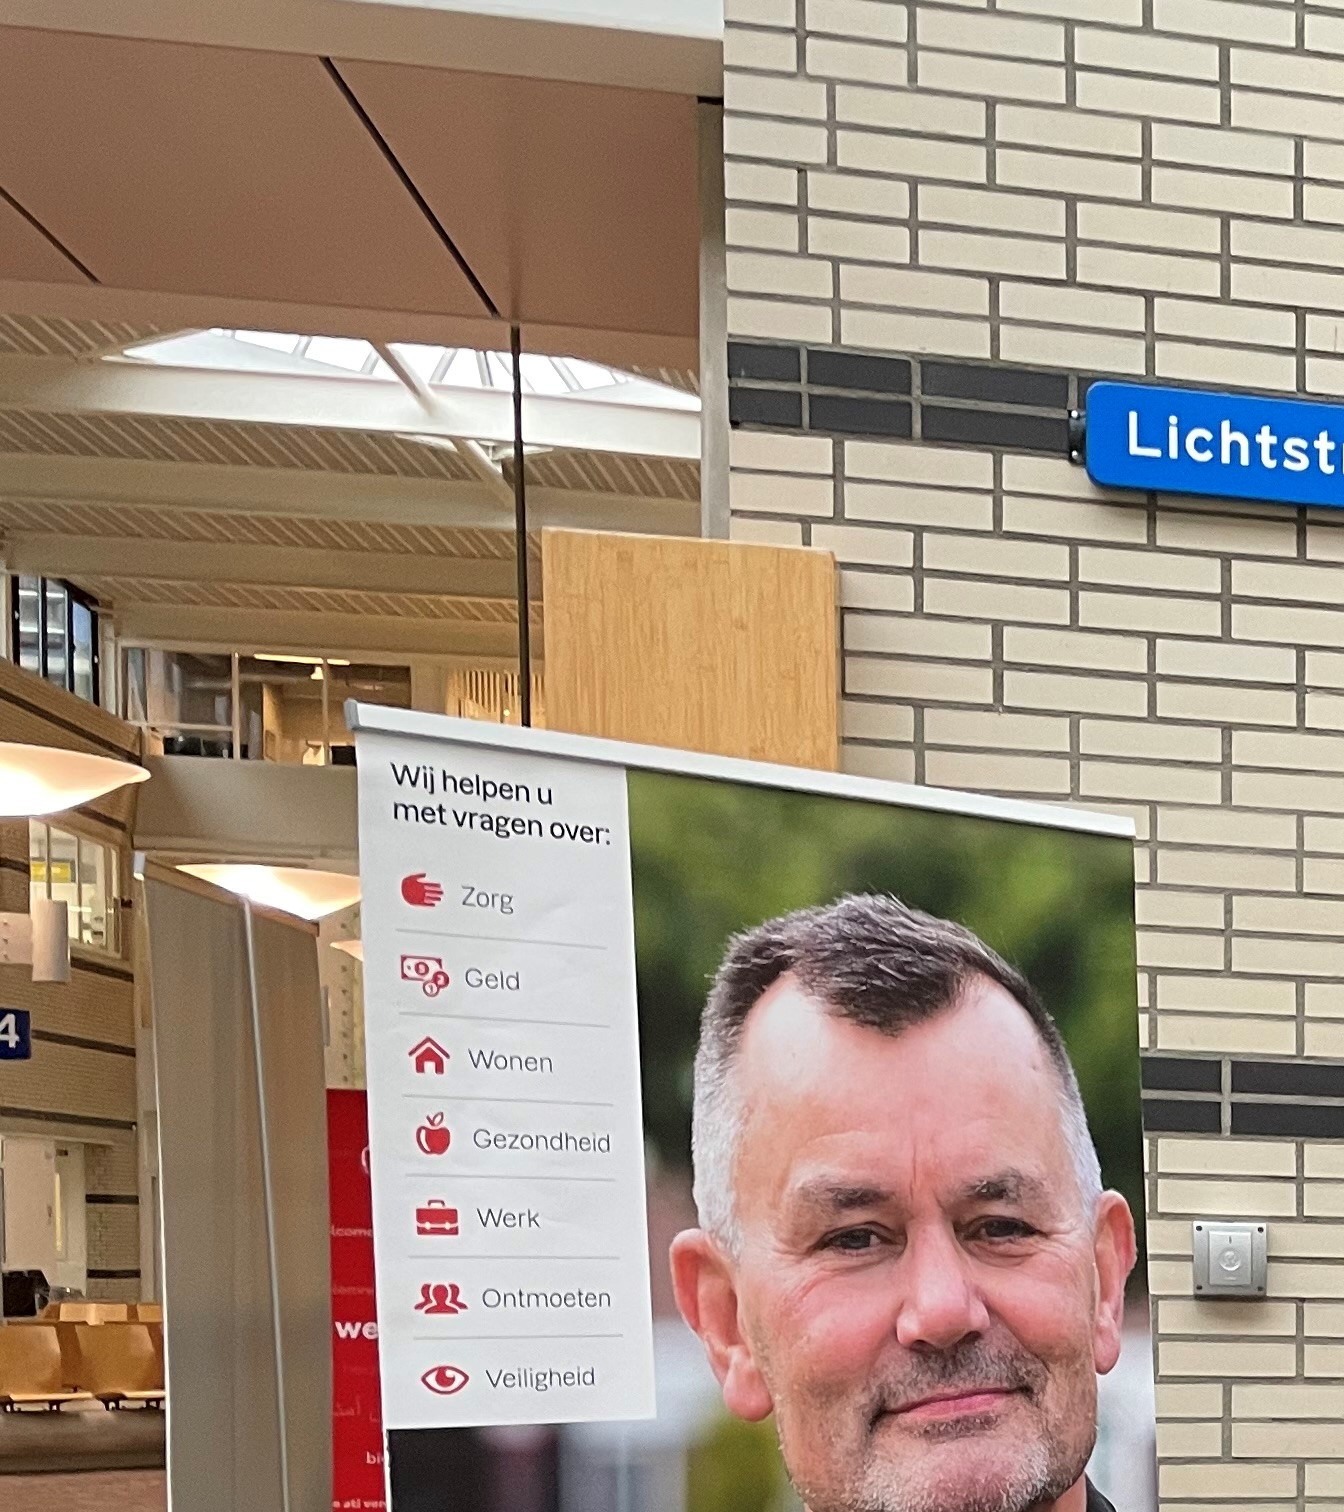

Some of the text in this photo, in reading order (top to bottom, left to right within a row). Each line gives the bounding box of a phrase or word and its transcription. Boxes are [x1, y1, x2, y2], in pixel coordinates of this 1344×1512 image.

[389, 762, 553, 806] Wij helpen u
[393, 801, 611, 845] met vragen over:
[461, 885, 514, 915] Zorg
[464, 967, 521, 992] Geld
[468, 1048, 553, 1073] Wonen
[473, 1128, 611, 1153] Gezondheid
[477, 1208, 540, 1229] Werk
[482, 1288, 611, 1309] Ontmoeten
[485, 1366, 595, 1392] Veiligheid
